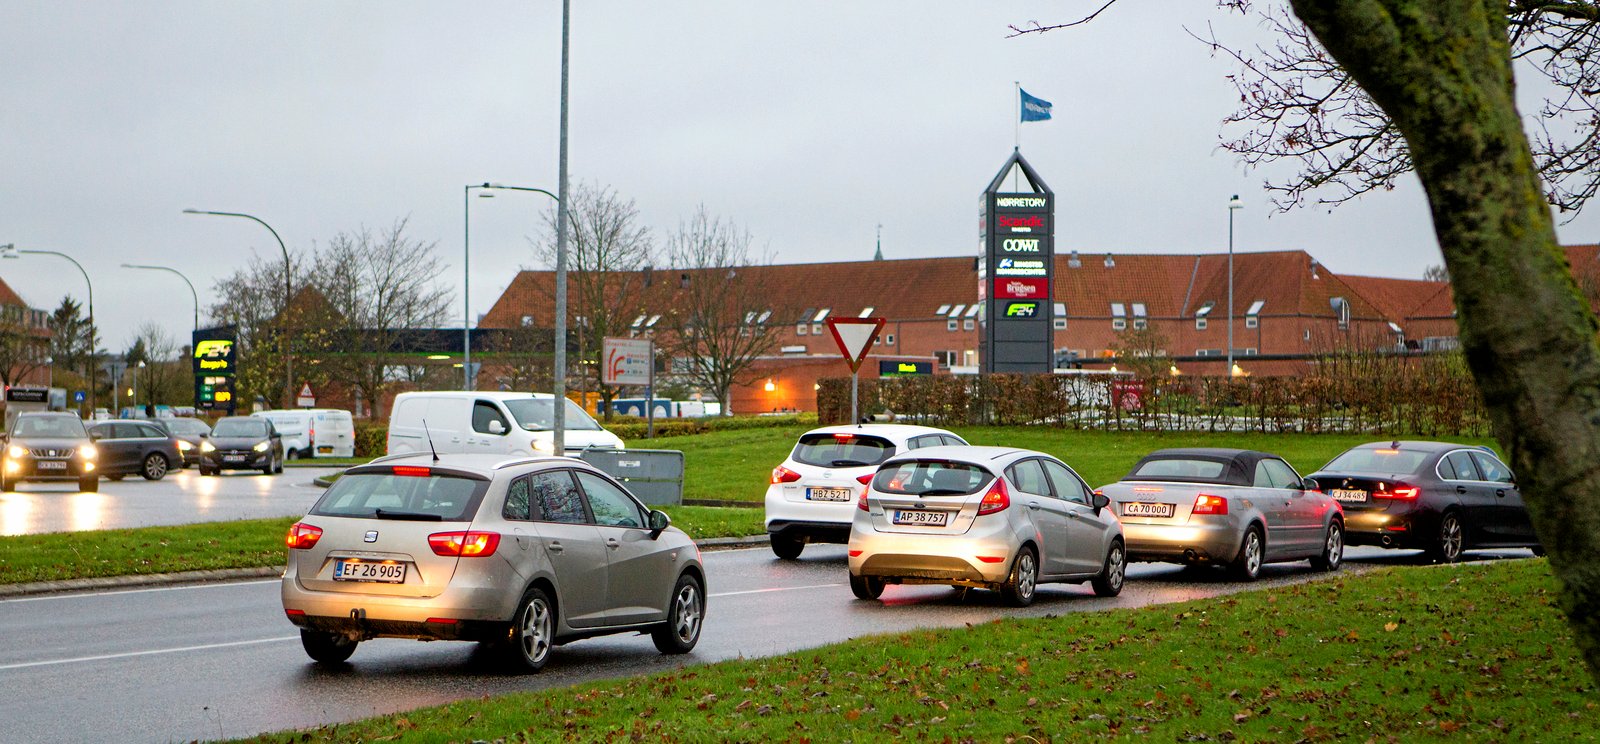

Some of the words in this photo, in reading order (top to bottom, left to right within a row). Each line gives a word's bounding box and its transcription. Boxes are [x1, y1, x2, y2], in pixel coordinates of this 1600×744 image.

[997, 197, 1047, 207] NØRRETORV
[999, 215, 1045, 227] Scandic
[1003, 238, 1040, 252] COWI
[1006, 283, 1036, 295] Brugsen
[1007, 303, 1036, 316] F24
[194, 340, 234, 359] F24
[813, 489, 829, 498] HBZ
[830, 490, 846, 499] 521
[1332, 490, 1342, 498] CJ
[1128, 504, 1139, 512] CA
[1140, 505, 1150, 513] 70
[1151, 505, 1167, 513] 000
[901, 512, 913, 521] AP
[914, 512, 926, 522] 38
[927, 513, 945, 523] 757
[343, 563, 360, 576] EF
[362, 564, 377, 577] 26
[380, 565, 402, 578] 905
